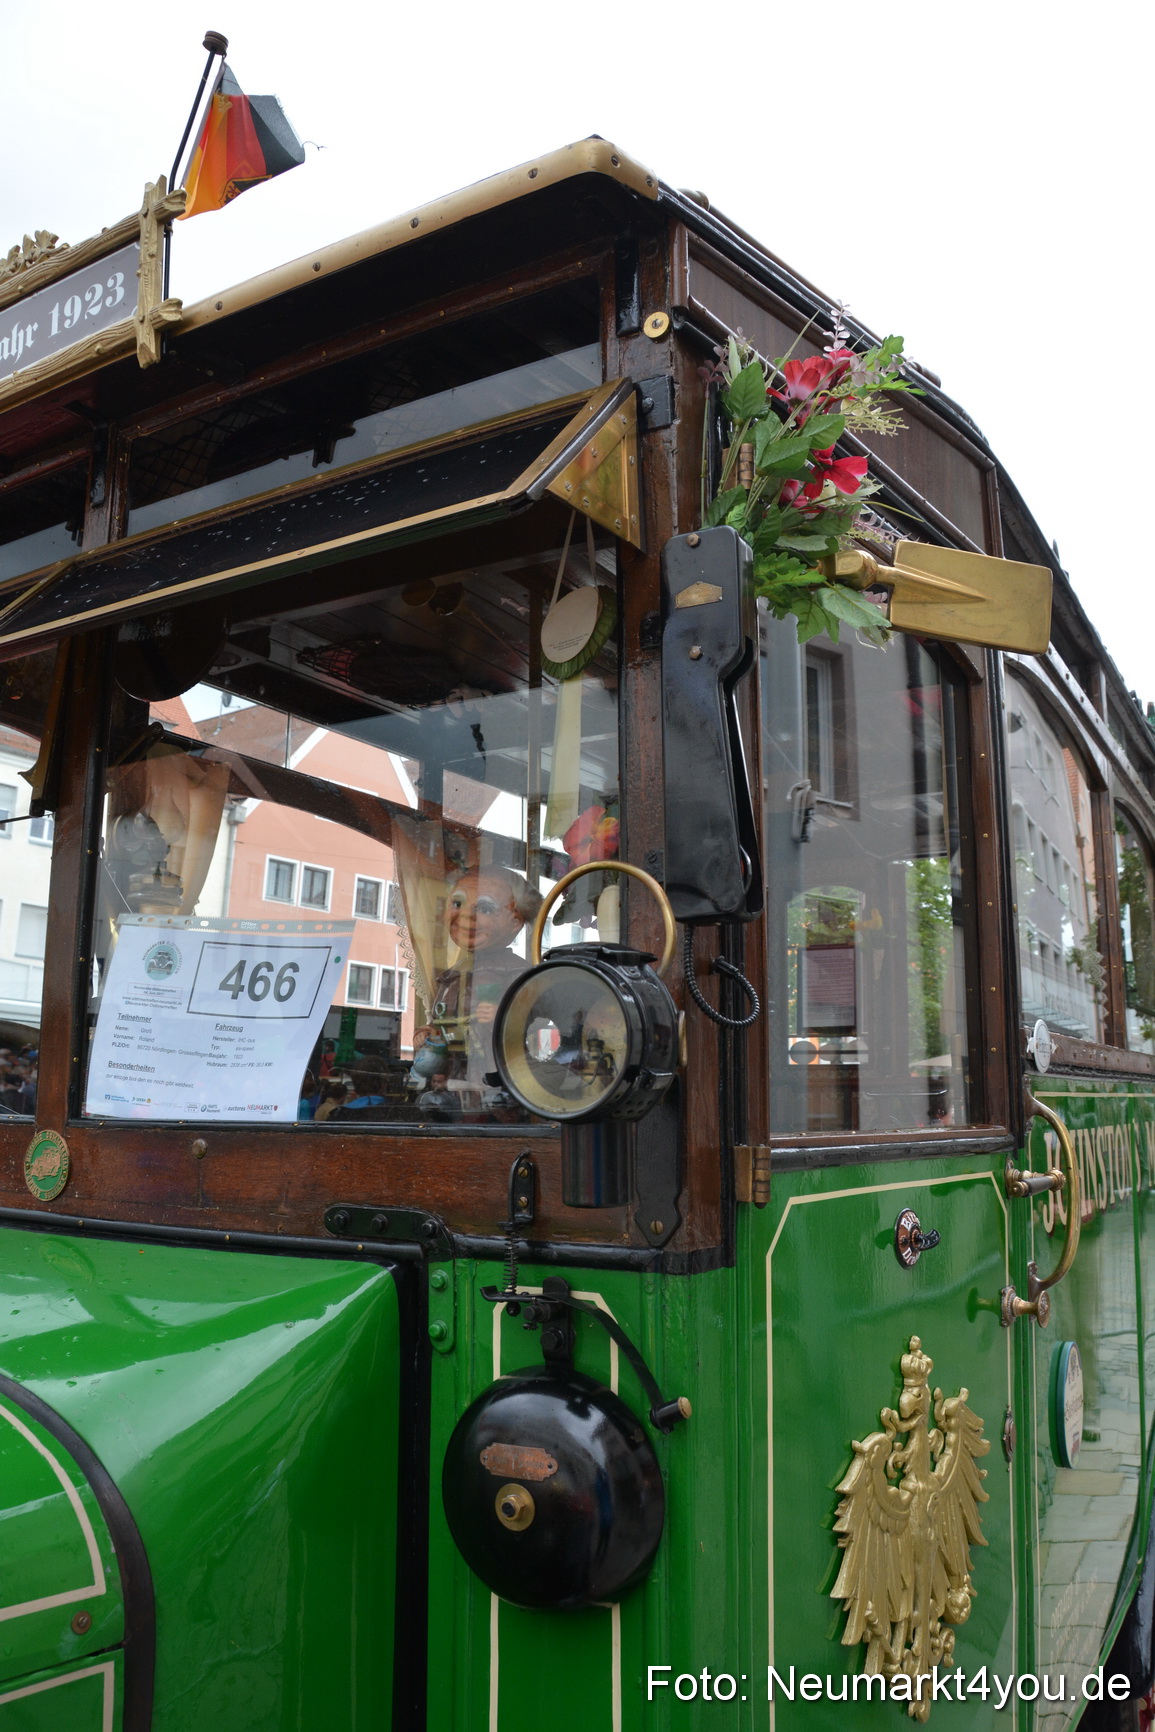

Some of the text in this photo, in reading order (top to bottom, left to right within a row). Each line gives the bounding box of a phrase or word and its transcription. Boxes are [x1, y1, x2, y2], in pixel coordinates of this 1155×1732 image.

[48, 272, 125, 338] 1923
[218, 960, 300, 1002] 466
[117, 1013, 152, 1023] Teilnehmer
[215, 1023, 244, 1032] Fahrzeug
[108, 1060, 155, 1073] Besonderheiten
